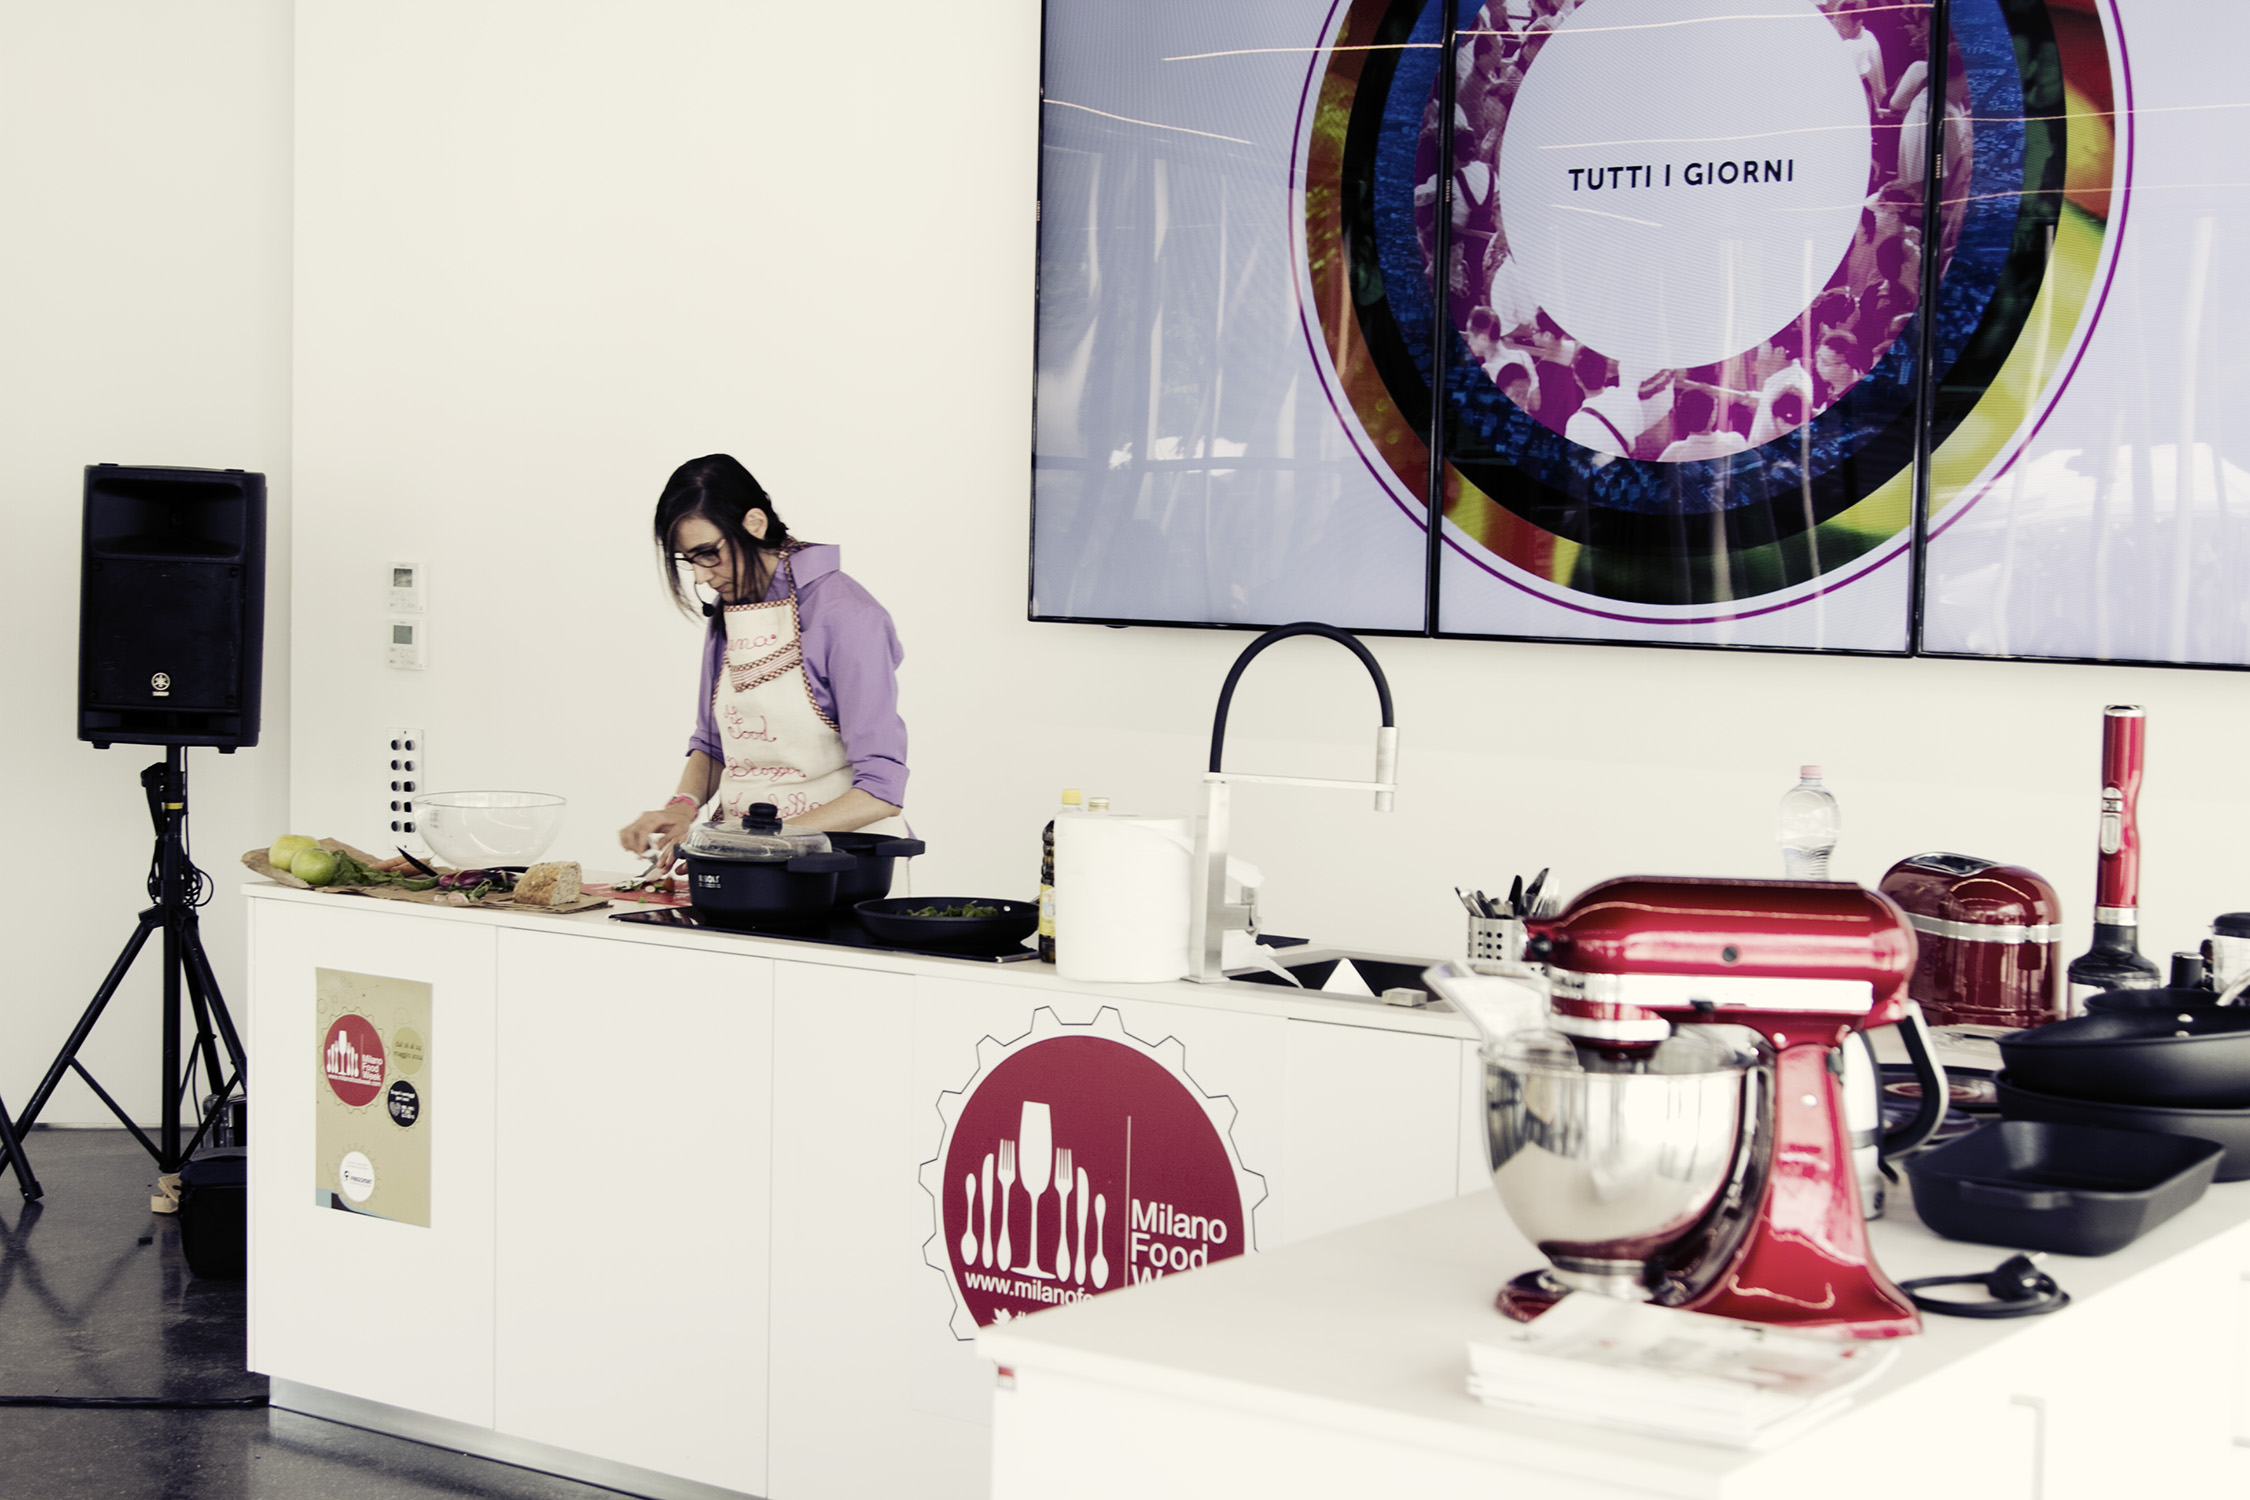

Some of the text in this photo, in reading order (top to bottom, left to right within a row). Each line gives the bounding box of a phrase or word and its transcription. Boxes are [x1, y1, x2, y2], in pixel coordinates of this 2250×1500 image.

[1568, 159, 1793, 191] TUTTI I GIORNI
[1131, 1198, 1227, 1244] Milano
[1131, 1231, 1208, 1272] Food
